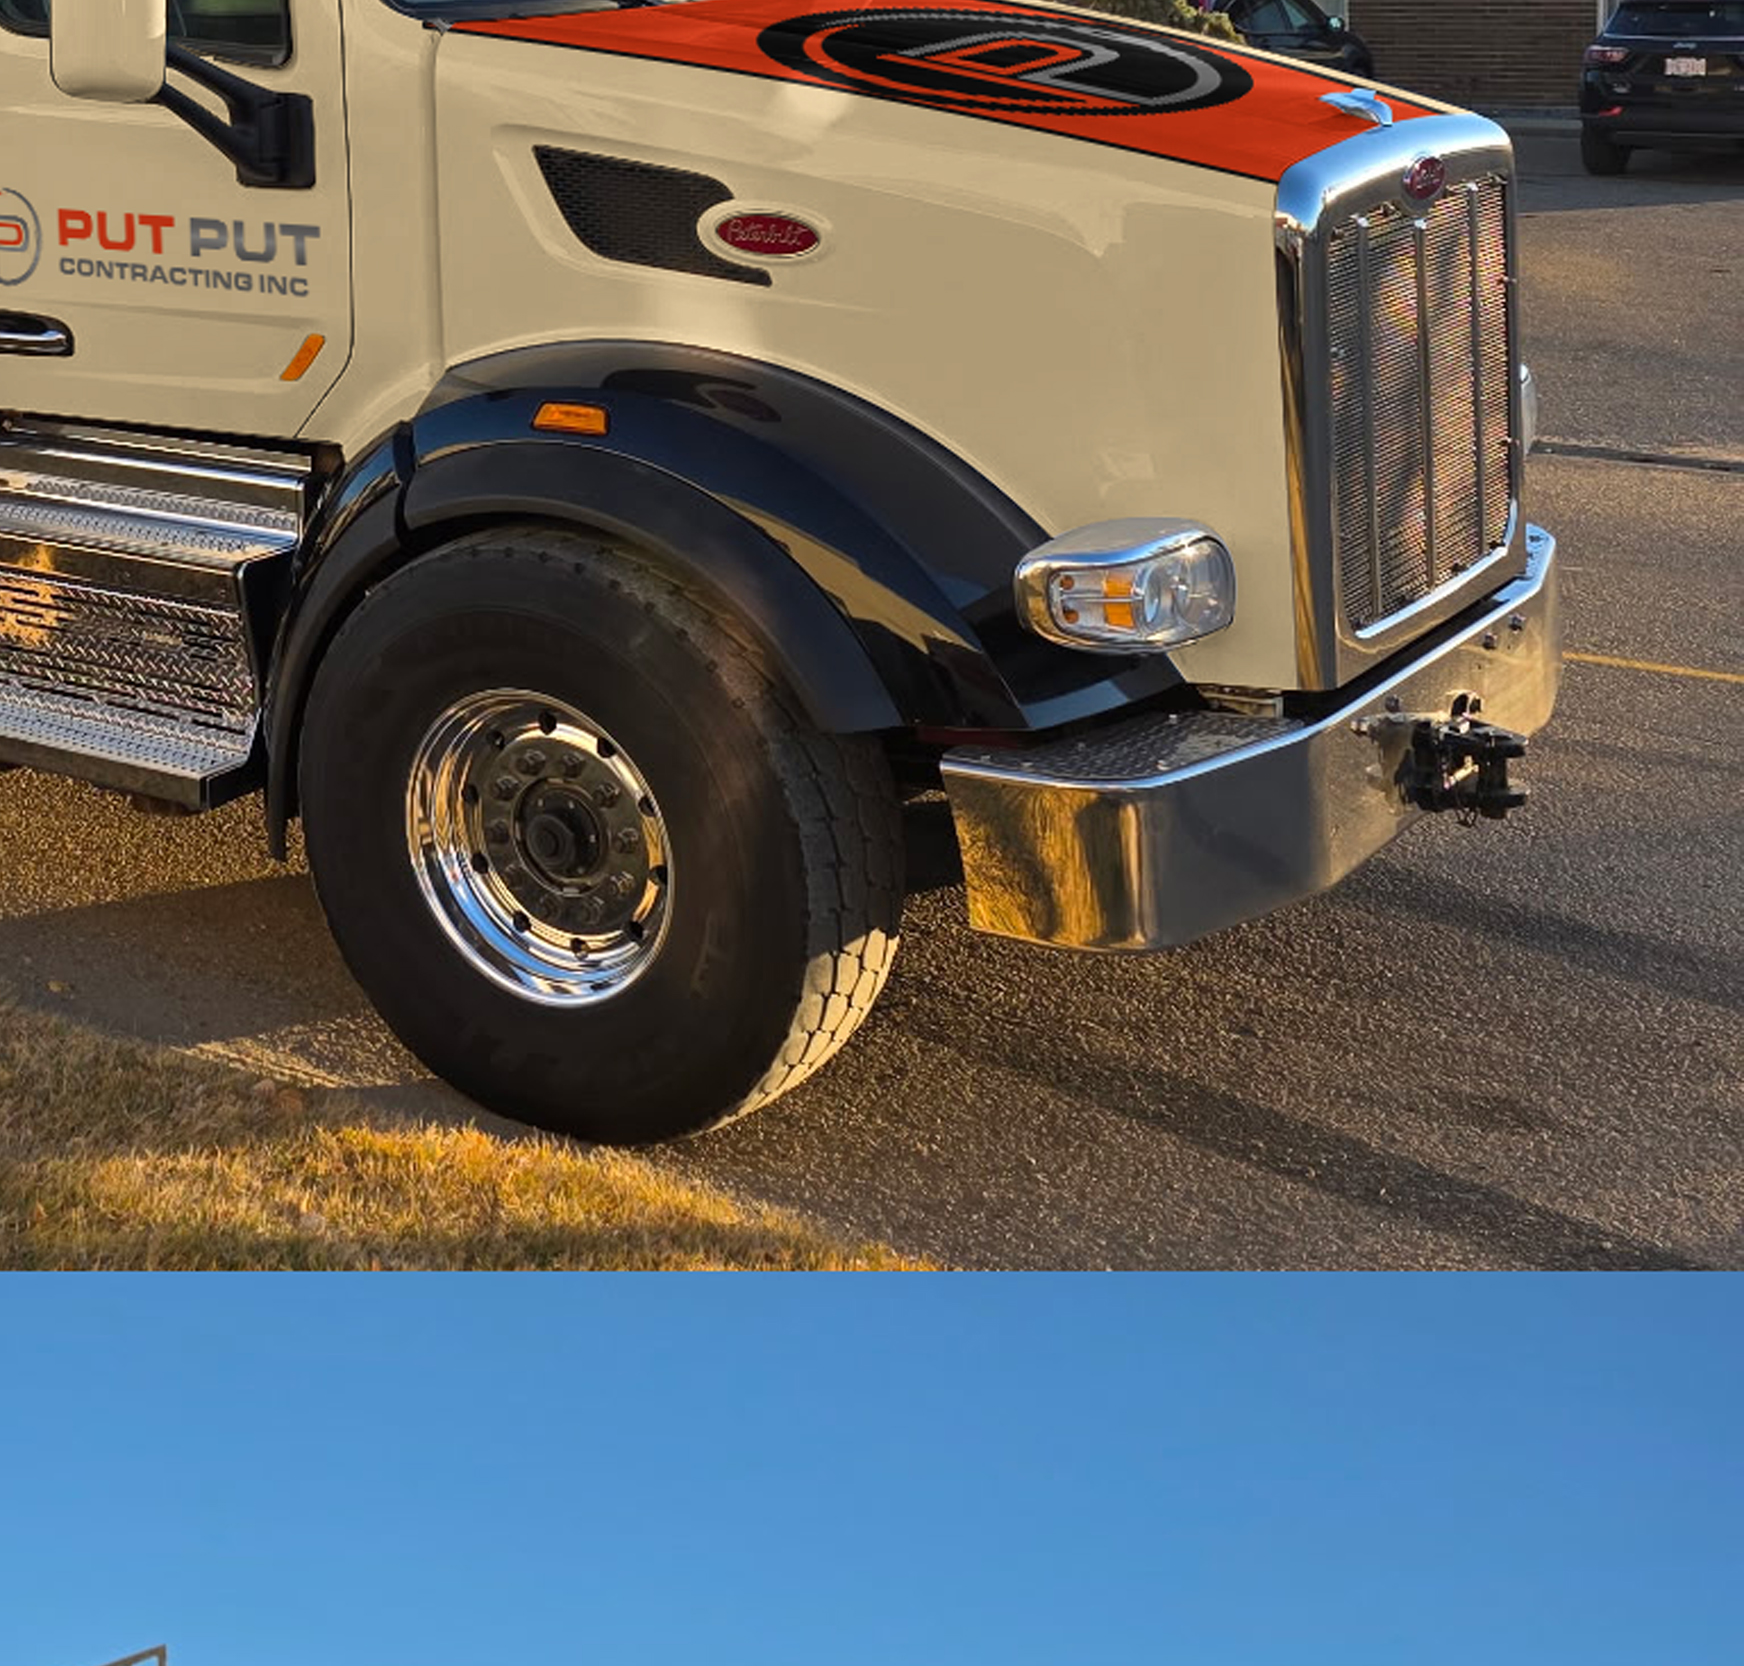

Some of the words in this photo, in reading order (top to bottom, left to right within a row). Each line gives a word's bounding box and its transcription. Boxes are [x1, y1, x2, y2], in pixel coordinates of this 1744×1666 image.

[58, 208, 175, 254] PUT
[190, 217, 321, 266] PUT
[59, 257, 253, 292] CONTRACTING
[260, 274, 309, 297] INC
